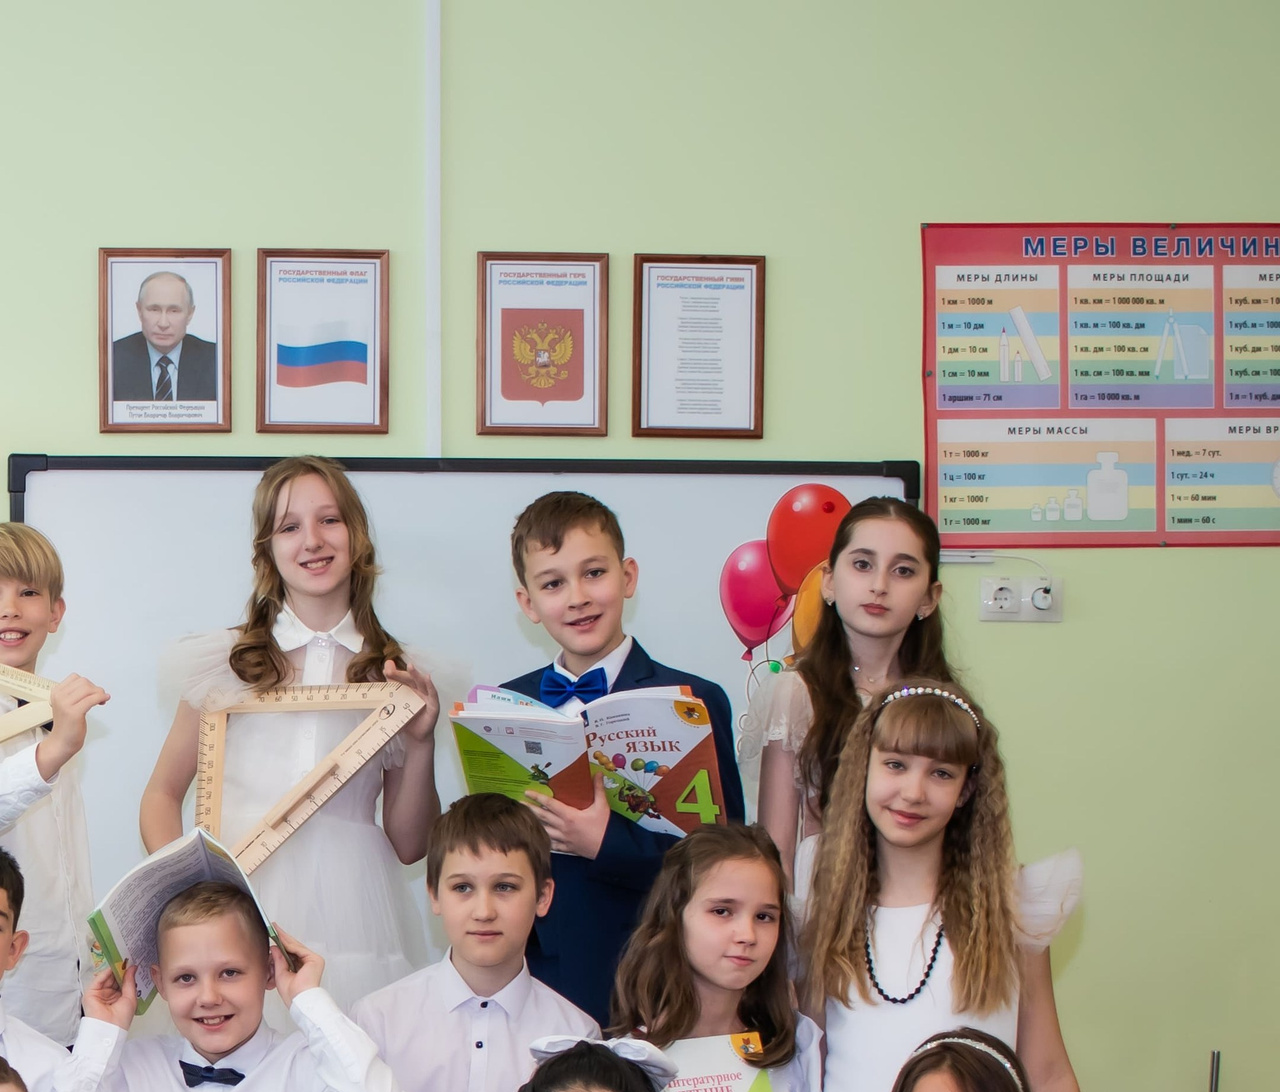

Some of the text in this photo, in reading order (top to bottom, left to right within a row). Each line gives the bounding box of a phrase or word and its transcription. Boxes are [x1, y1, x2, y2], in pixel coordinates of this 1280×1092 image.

[1023, 237, 1280, 257] МЕРЫ ВЕЛИЧИН
[957, 274, 1038, 283] МЕРЫ ДЛИНЫ
[1130, 274, 1189, 283] ПЛОЩАДИ
[1008, 426, 1088, 435] МЕРЫ МАССЫ
[1228, 426, 1261, 434] МЕРЫ
[963, 450, 979, 458] 1000
[967, 495, 984, 503] 1000
[1202, 516, 1210, 524] 60
[586, 726, 657, 749] Русский
[675, 769, 720, 824] 4
